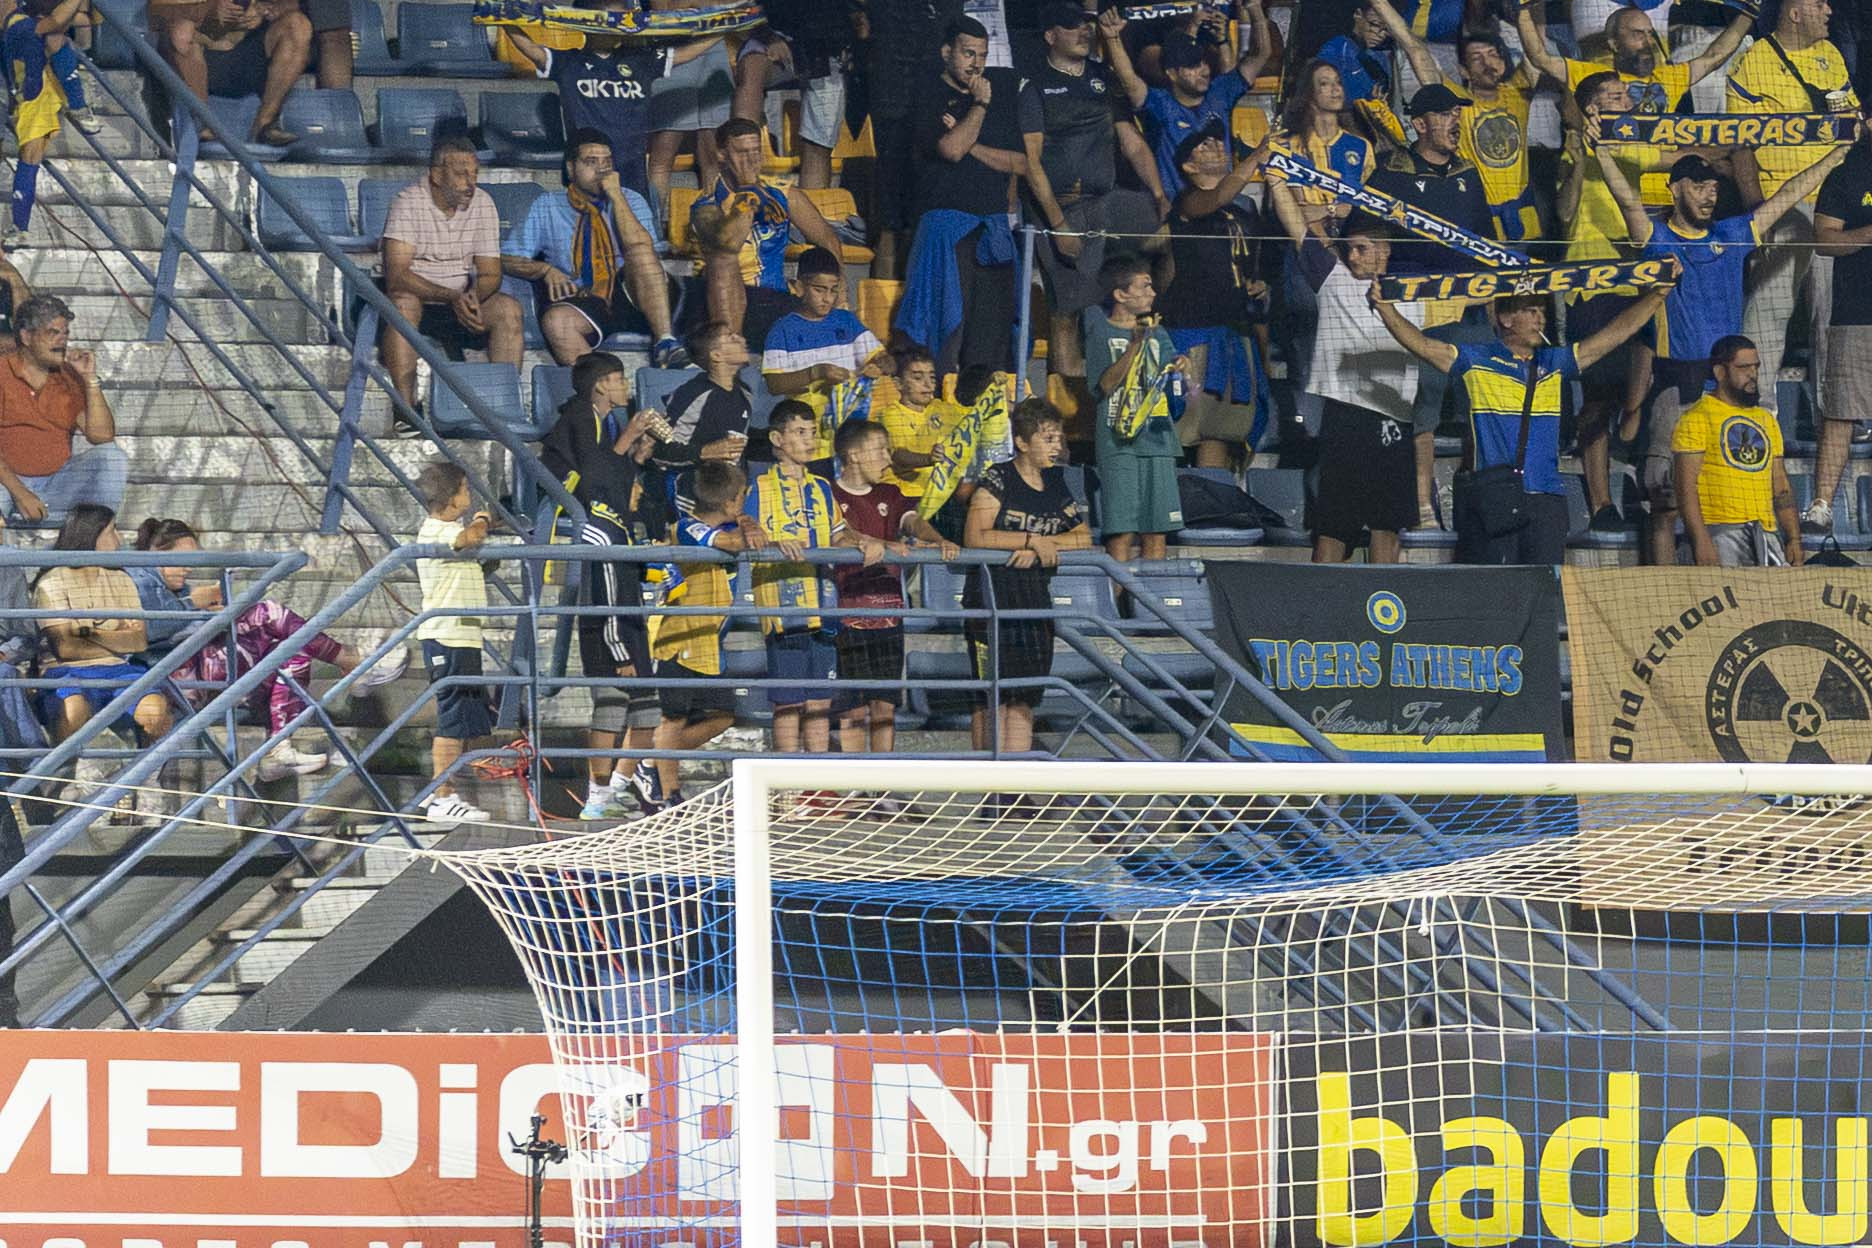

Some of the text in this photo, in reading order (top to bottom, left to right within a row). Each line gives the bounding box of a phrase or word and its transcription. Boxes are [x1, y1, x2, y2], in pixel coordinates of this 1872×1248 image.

[1651, 115, 1809, 143] ASTERAS
[1408, 208, 1530, 267] ΤΡΙΠΟΛ
[1398, 259, 1664, 303] TIGERS
[1249, 638, 1523, 696] TIGERS ATHENS
[1713, 638, 1759, 737] ΑΣΤΕΡΑΣ
[1608, 688, 1645, 763] Old
